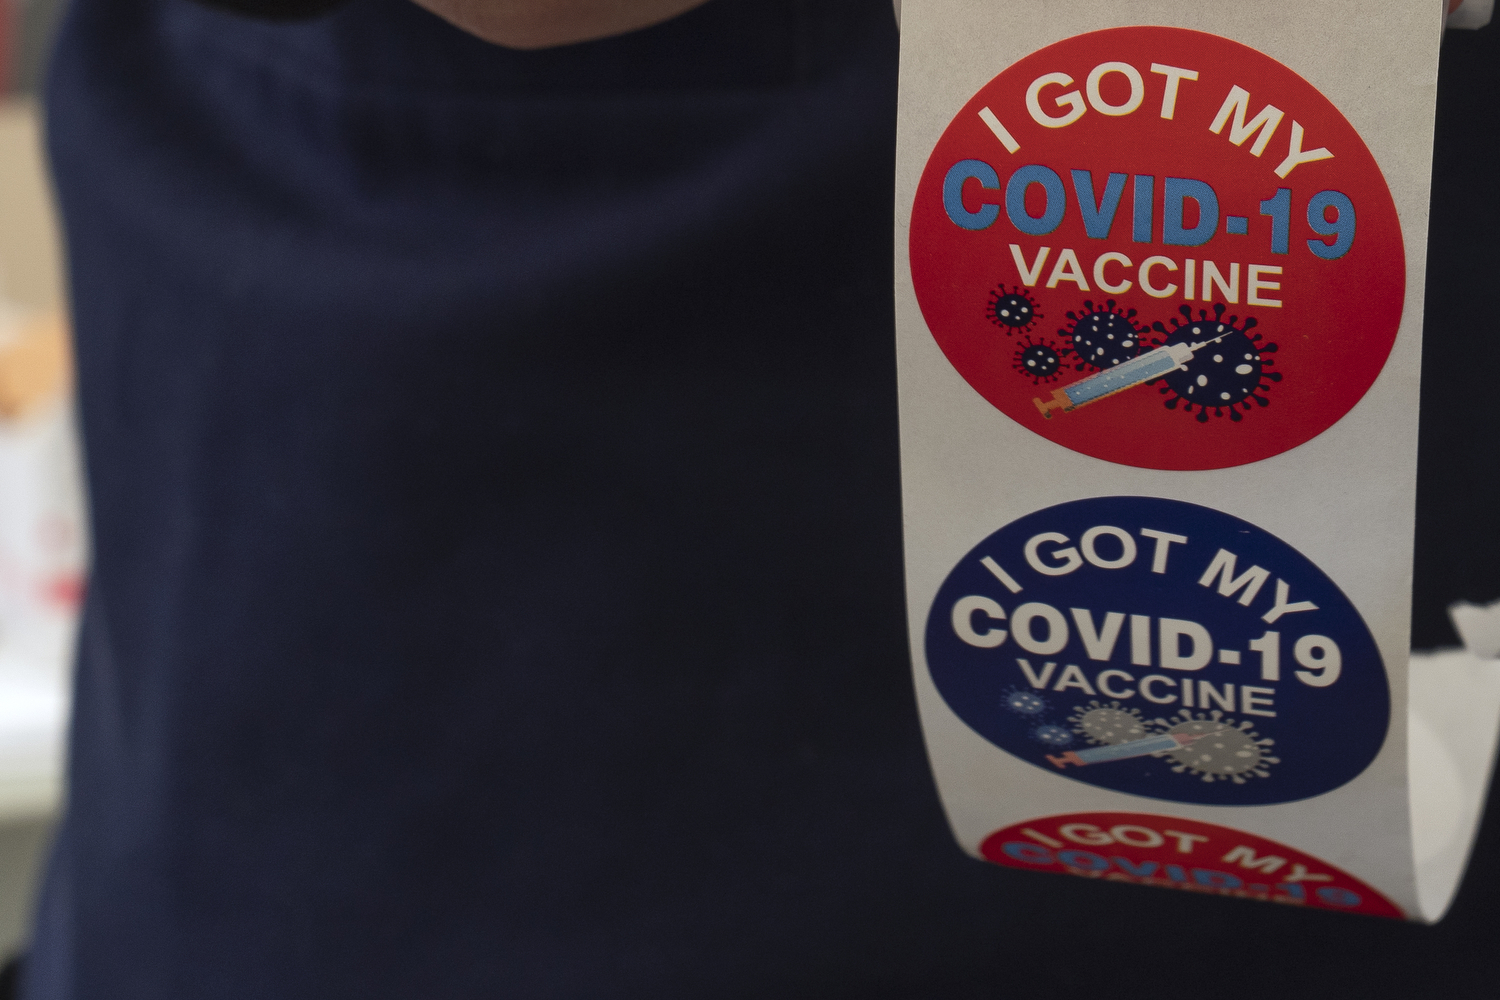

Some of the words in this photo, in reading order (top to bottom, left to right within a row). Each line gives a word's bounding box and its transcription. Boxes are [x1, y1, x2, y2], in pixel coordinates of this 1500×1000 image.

[977, 106, 1021, 154] I
[1025, 61, 1199, 128] GOT
[1209, 85, 1334, 179] MY
[943, 159, 1356, 259] COVID-19
[1009, 244, 1283, 308] VACCINE
[980, 556, 1023, 594] I
[1023, 525, 1188, 576] GOT
[1198, 548, 1319, 625] MY
[951, 595, 1342, 687] COVID-19
[1015, 658, 1277, 718] VACCINE
[1000, 841, 1362, 906] COVID-19
[1021, 827, 1063, 848] I
[1059, 822, 1209, 853] GOT
[1222, 845, 1334, 883] MY
